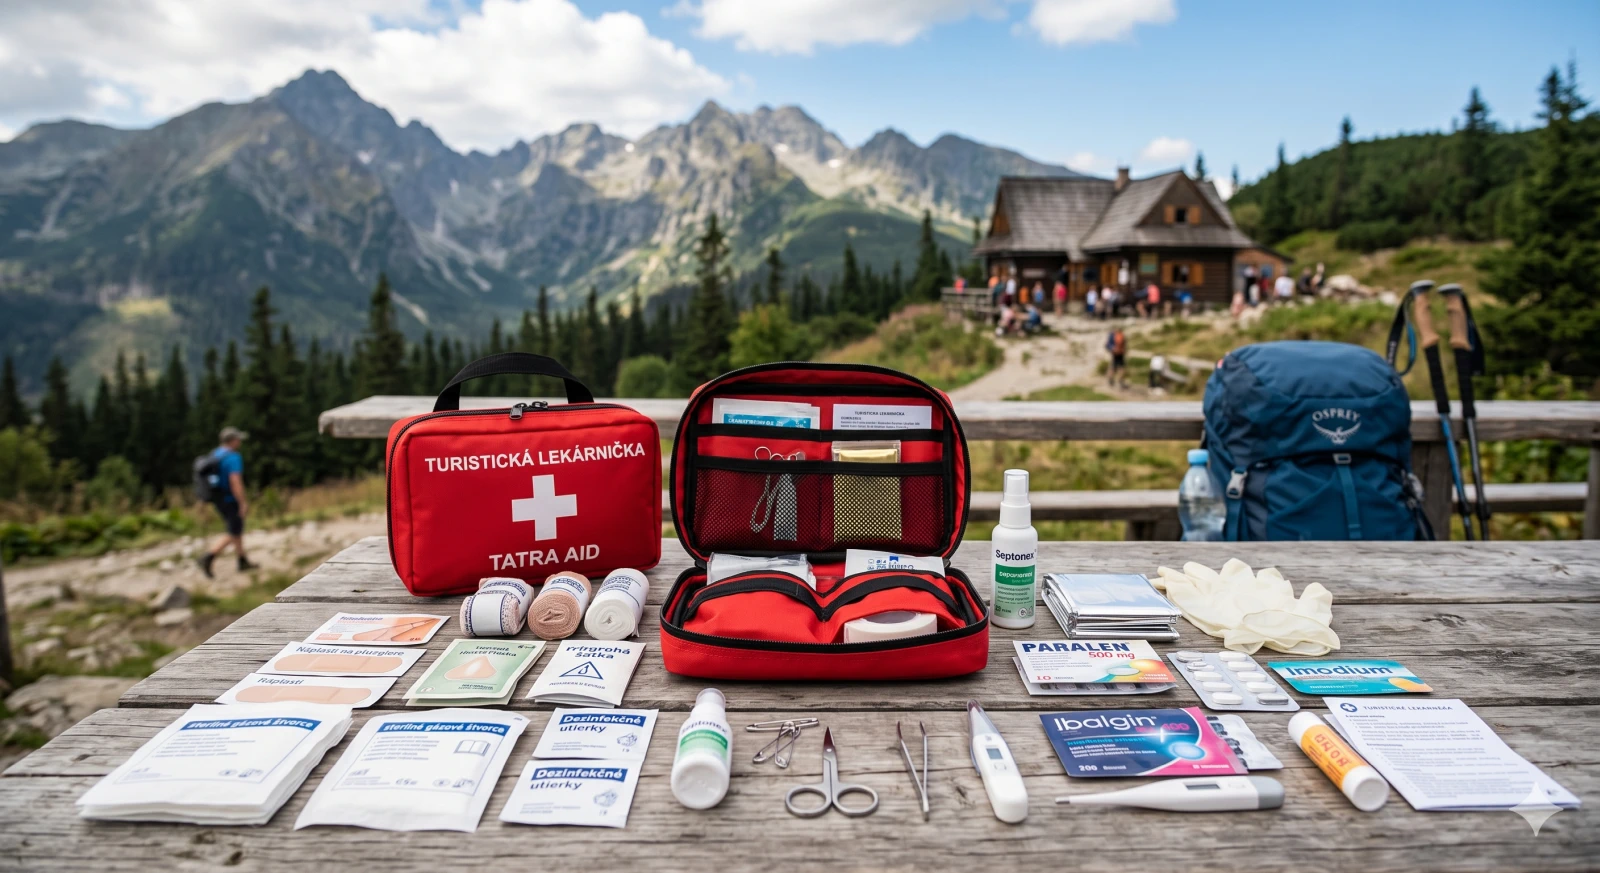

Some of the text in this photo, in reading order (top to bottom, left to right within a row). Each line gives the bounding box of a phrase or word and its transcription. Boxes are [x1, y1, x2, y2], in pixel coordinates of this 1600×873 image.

[1312, 408, 1361, 422] OSPREY
[425, 441, 645, 472] TURISTICKÁ LEKÁRNIČKA
[489, 544, 600, 571] TATRA AID
[995, 549, 1035, 561] Septonex
[1022, 642, 1130, 652] PARALEN
[1088, 651, 1136, 660] 500 mg
[1285, 665, 1394, 676] Imodium
[563, 714, 641, 725] Dezinfekčné
[425, 723, 464, 733] gázové
[465, 723, 505, 734] štvorce
[559, 724, 607, 733] utierky
[536, 767, 623, 779] Dezinfekčné
[1078, 764, 1098, 772] 200
[530, 781, 582, 790] utierky
